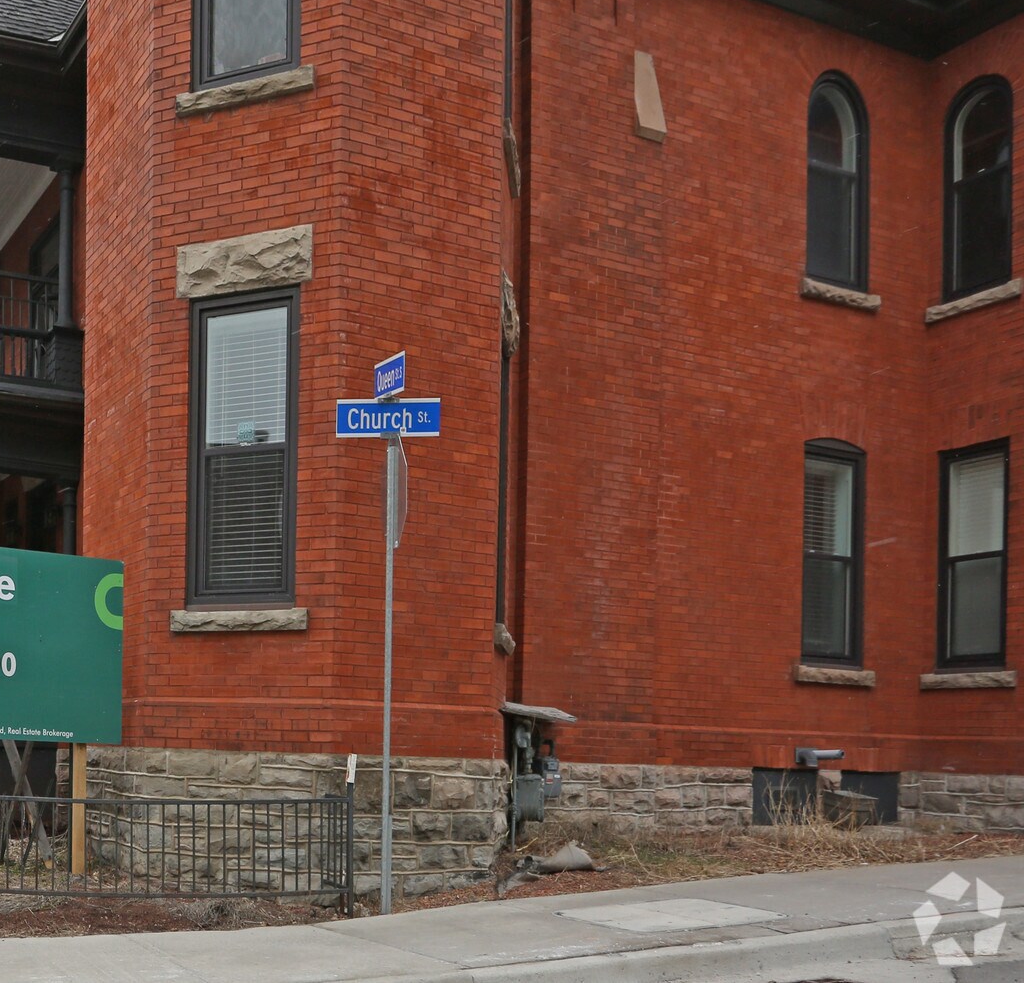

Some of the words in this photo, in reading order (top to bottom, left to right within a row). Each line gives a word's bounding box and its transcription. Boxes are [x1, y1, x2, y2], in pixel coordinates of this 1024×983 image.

[377, 370, 395, 392] Queen
[347, 408, 413, 429] Church
[417, 411, 431, 423] St.
[7, 727, 21, 735] Real
[23, 727, 41, 736] Estate
[42, 728, 74, 739] Brokerage
